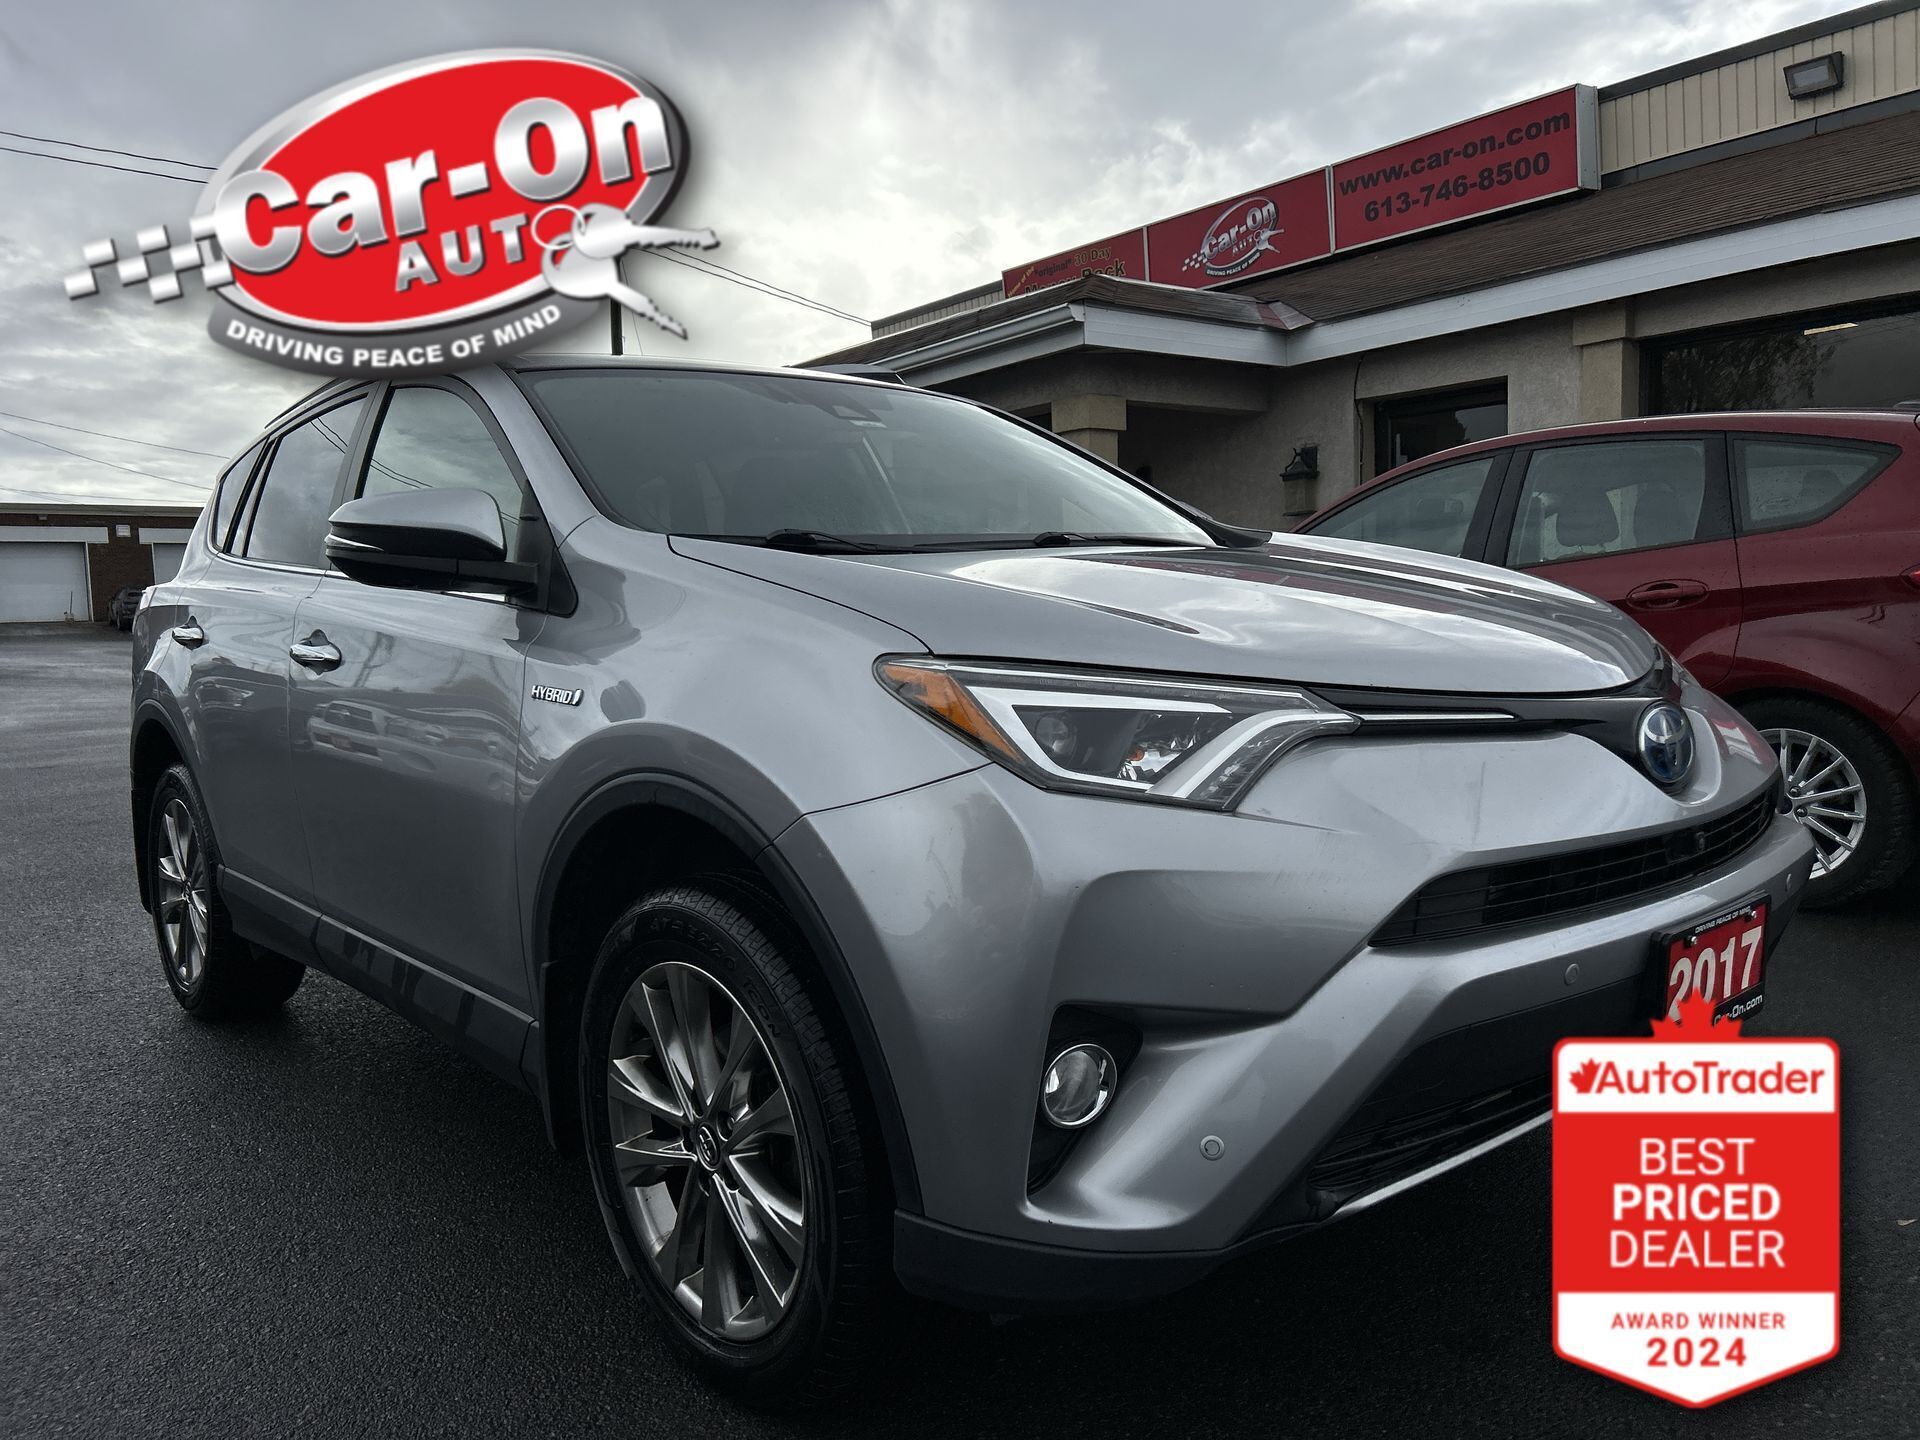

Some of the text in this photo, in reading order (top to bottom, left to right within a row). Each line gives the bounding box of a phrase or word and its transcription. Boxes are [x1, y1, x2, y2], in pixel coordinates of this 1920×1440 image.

[1338, 111, 1571, 196] www.car-on.com
[1364, 151, 1551, 222] 613-746-8500
[1074, 251, 1088, 266] 30
[1090, 246, 1112, 261] Day
[1204, 202, 1277, 259] Car-On
[531, 685, 573, 704] HYBRID
[1667, 925, 1762, 1022] 2017
